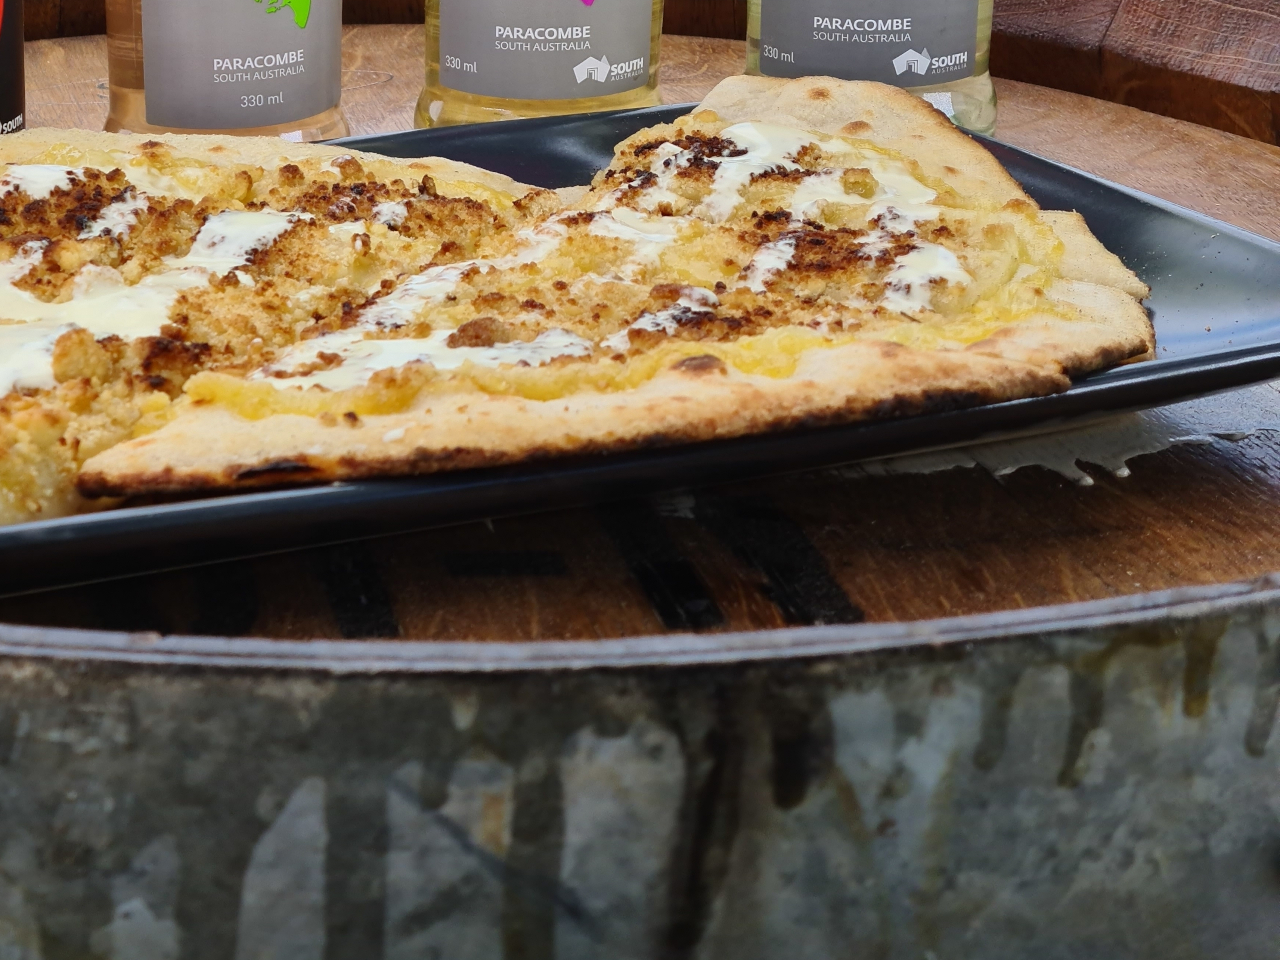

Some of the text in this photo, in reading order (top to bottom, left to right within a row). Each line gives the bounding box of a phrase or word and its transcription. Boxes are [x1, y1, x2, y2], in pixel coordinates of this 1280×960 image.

[813, 16, 911, 31] PARACOMBE
[495, 26, 591, 39] PARACOMBE
[813, 31, 911, 43] SOUTH AUSTRALIA
[495, 41, 591, 51] SOUTH AUSTRALIA
[213, 49, 305, 71] PARACOMBE
[763, 45, 795, 64] 330 ml
[931, 51, 968, 68] SOUTH
[445, 55, 478, 73] 330 ml
[611, 57, 644, 75] SOUTH
[931, 63, 968, 74] AUSTRALIA
[213, 64, 305, 83] SOUTH AUSTRALIA
[611, 69, 644, 81] AUSTRALIA
[240, 92, 284, 108] 330 ml
[2, 113, 23, 134] SOUTH
